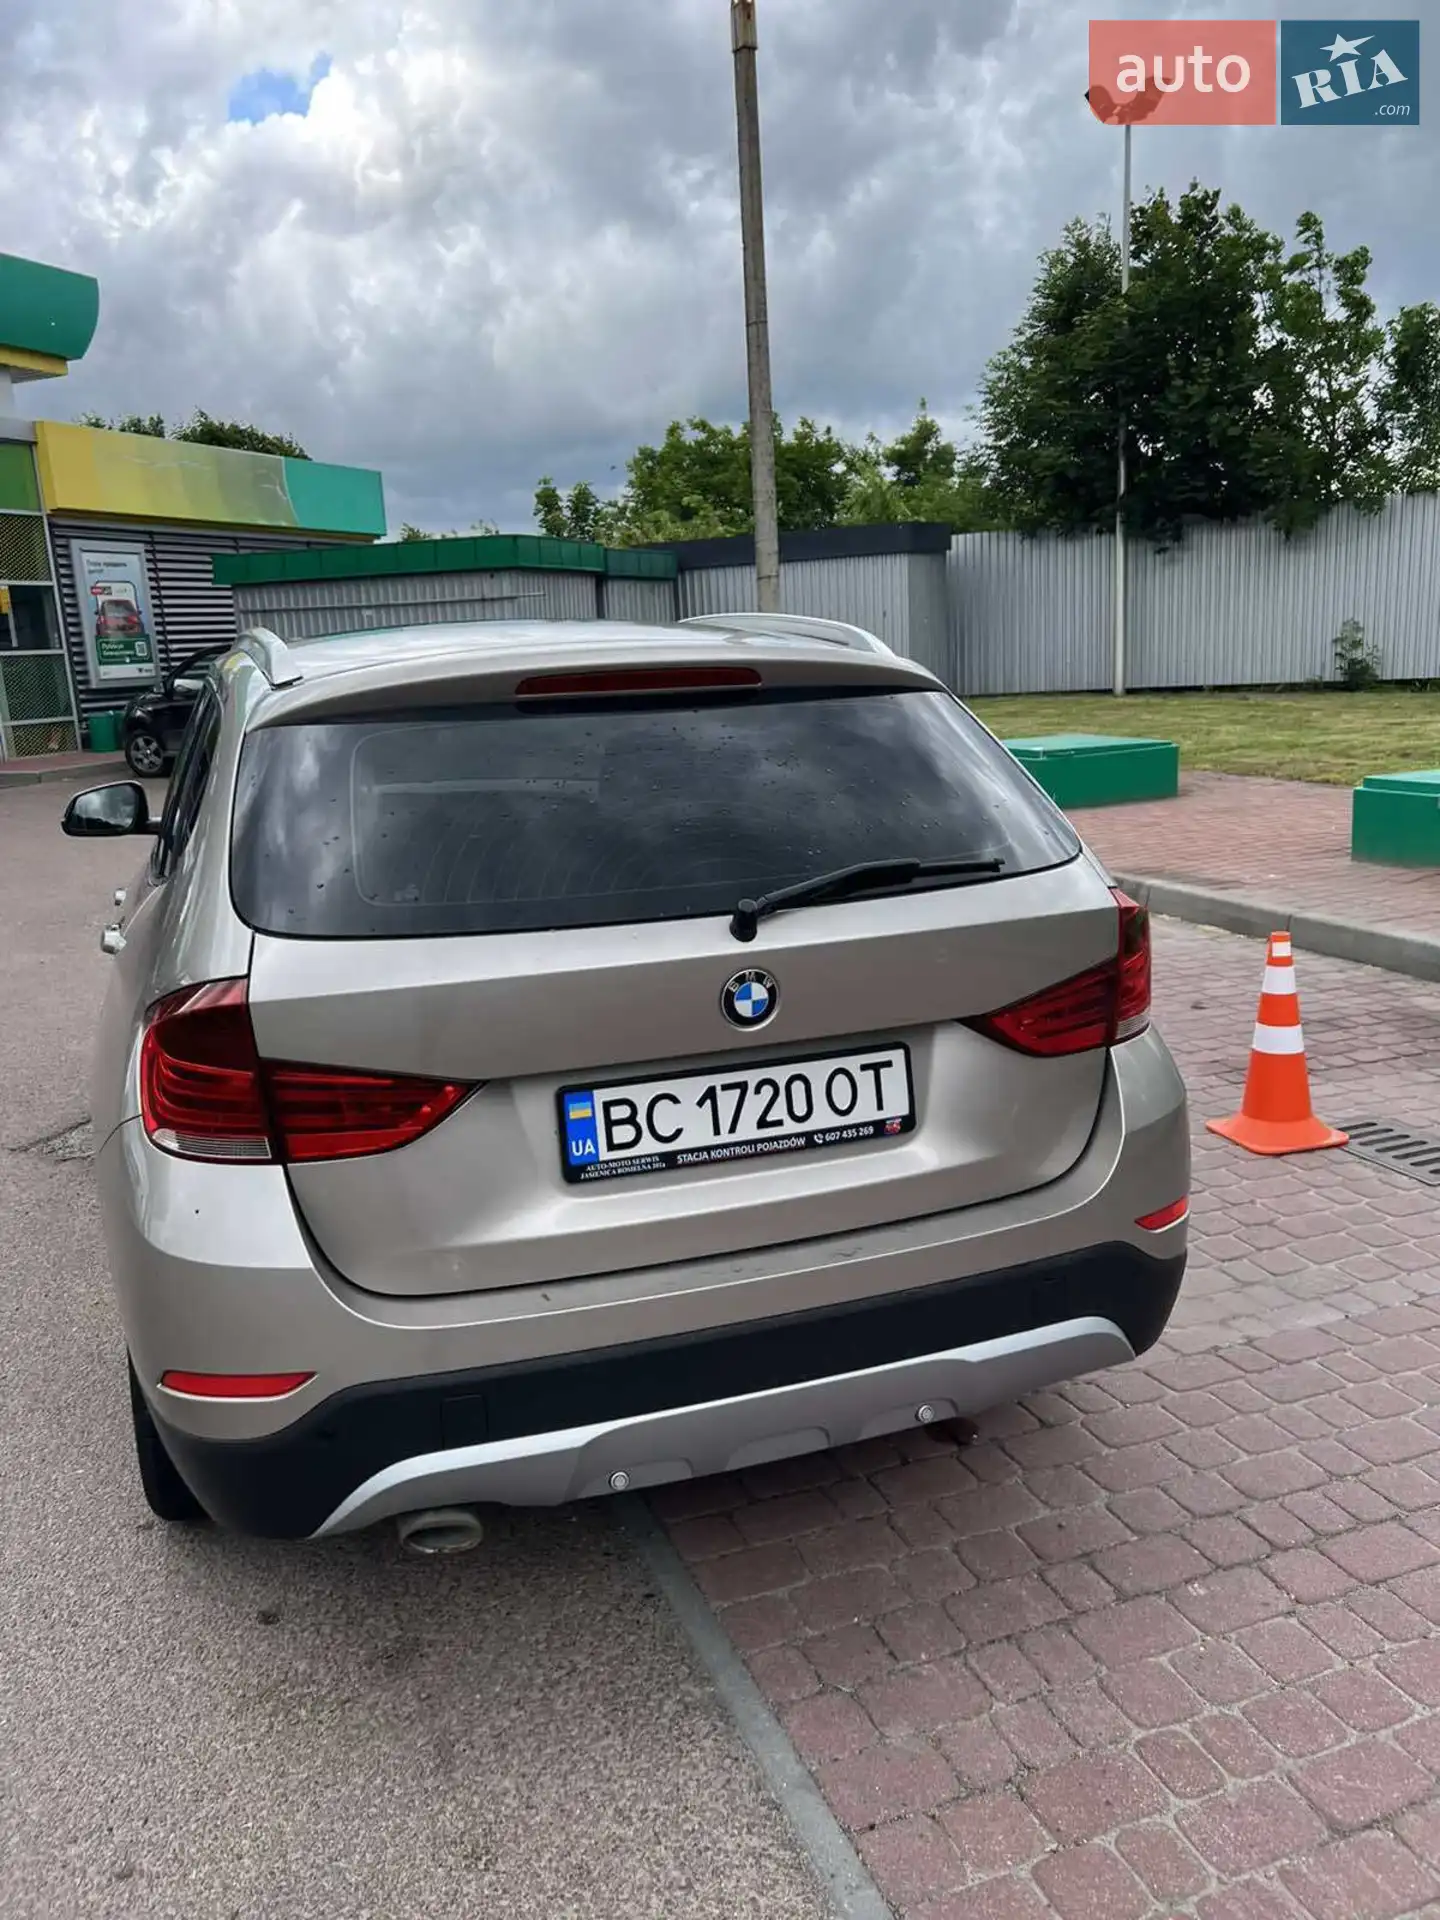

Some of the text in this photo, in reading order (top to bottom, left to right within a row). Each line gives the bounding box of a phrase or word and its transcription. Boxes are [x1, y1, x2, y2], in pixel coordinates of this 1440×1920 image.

[728, 971, 773, 992] BMW
[602, 1060, 893, 1152] BC 1720 OT
[571, 1139, 596, 1157] UA
[677, 1125, 874, 1165] STACJA KONTROLI POJAZDÓW 607 435 269
